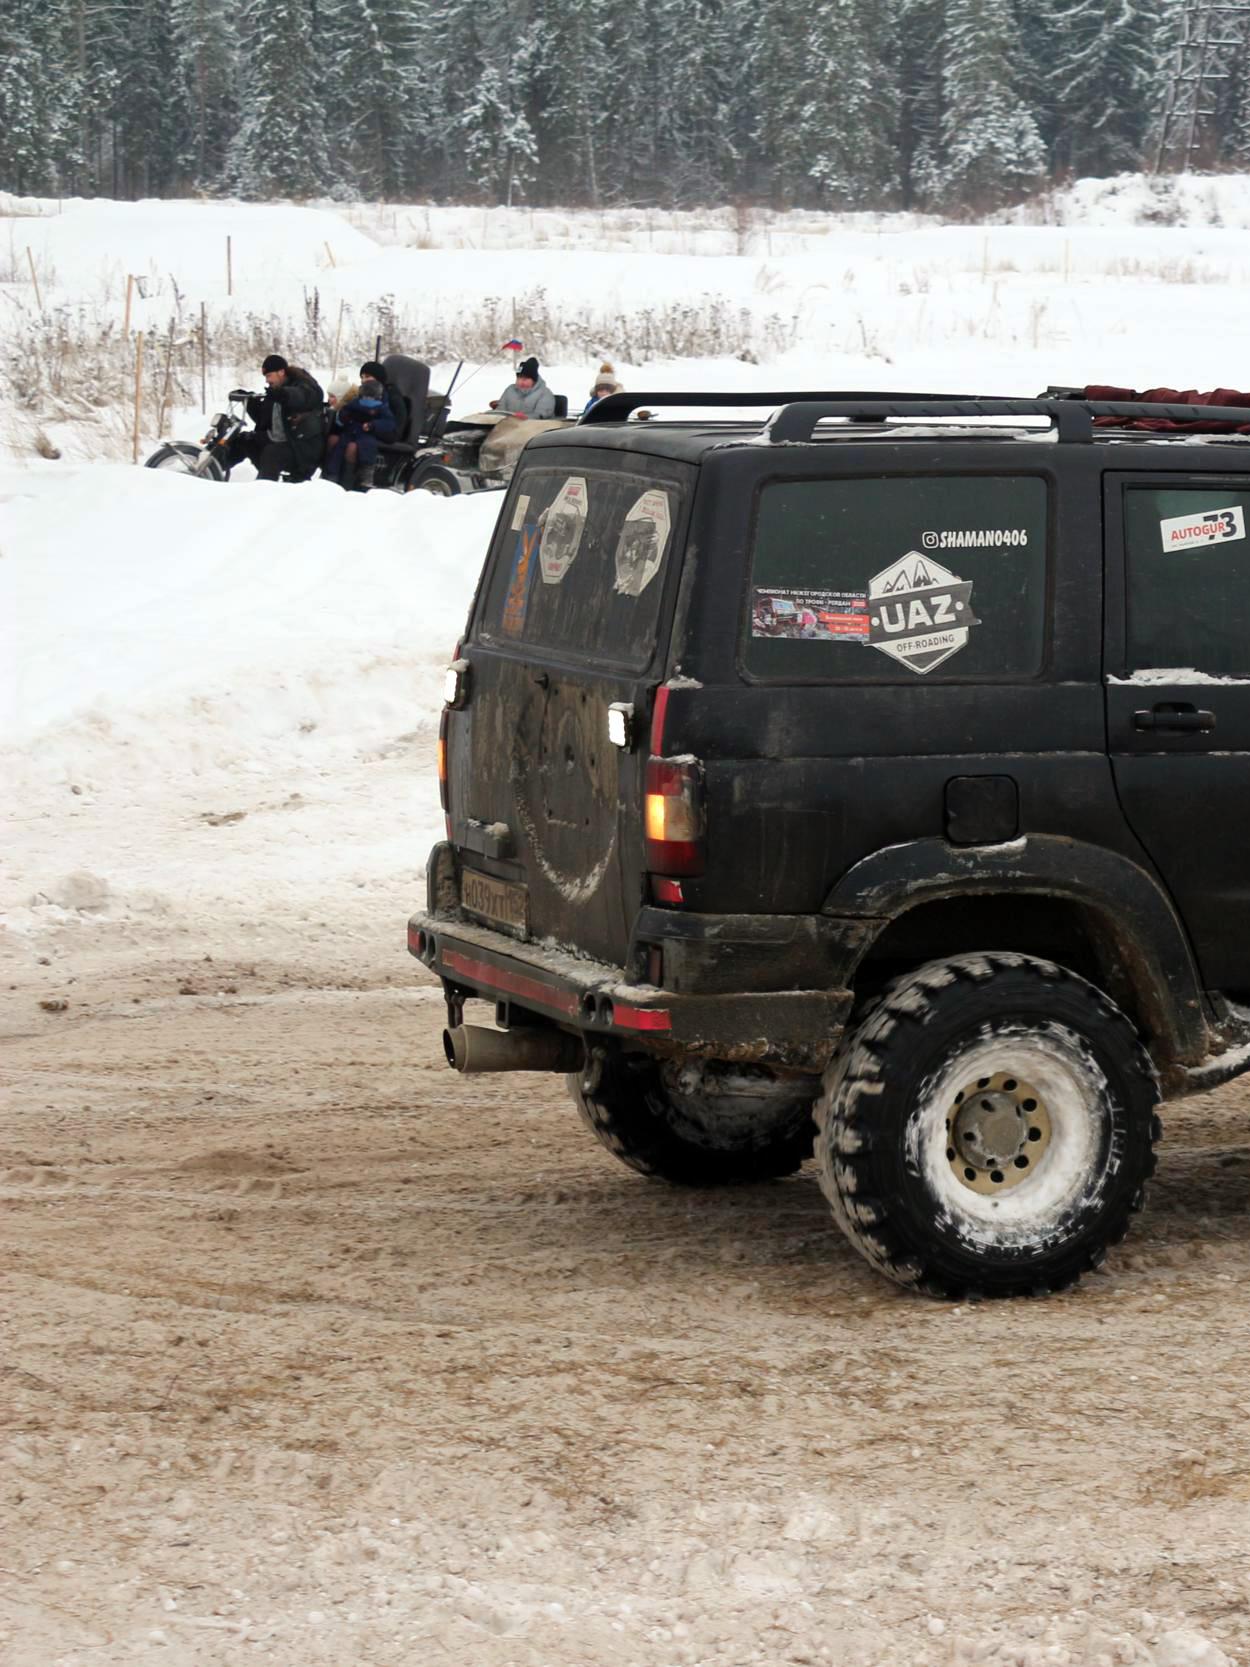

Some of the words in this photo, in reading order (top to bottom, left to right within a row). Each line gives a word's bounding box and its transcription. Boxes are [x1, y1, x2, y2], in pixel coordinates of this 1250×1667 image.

[1171, 521, 1226, 541] AUTOGUR
[880, 594, 957, 633] UAZ
[896, 634, 955, 652] OFF-ROADING
